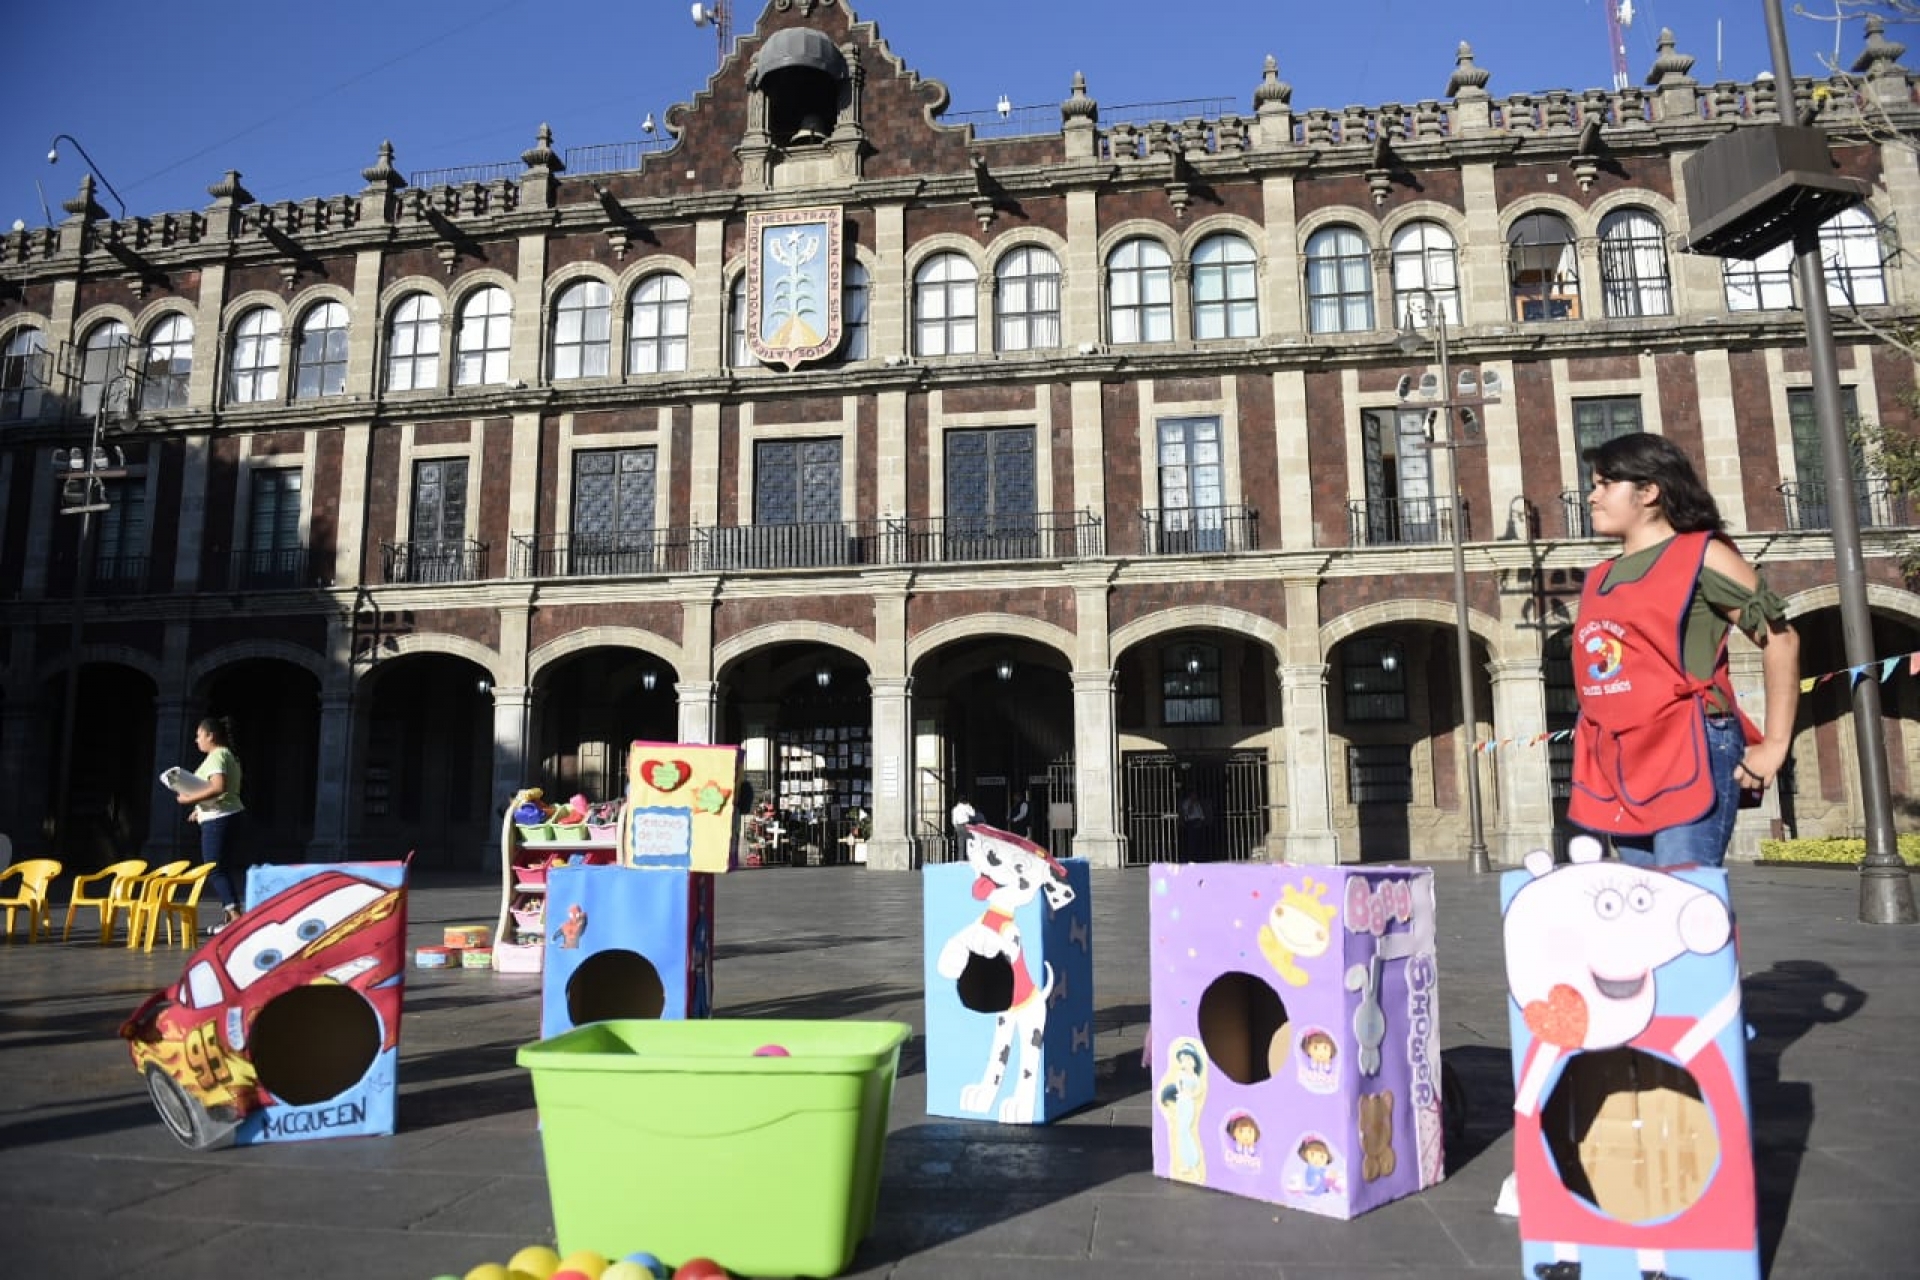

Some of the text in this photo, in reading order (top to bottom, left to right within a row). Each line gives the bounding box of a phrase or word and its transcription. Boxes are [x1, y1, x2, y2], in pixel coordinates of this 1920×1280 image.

[830, 261, 840, 290] CON
[830, 298, 840, 322] SUS
[185, 1020, 232, 1091] 95
[261, 1096, 367, 1139] MCQUEEN
